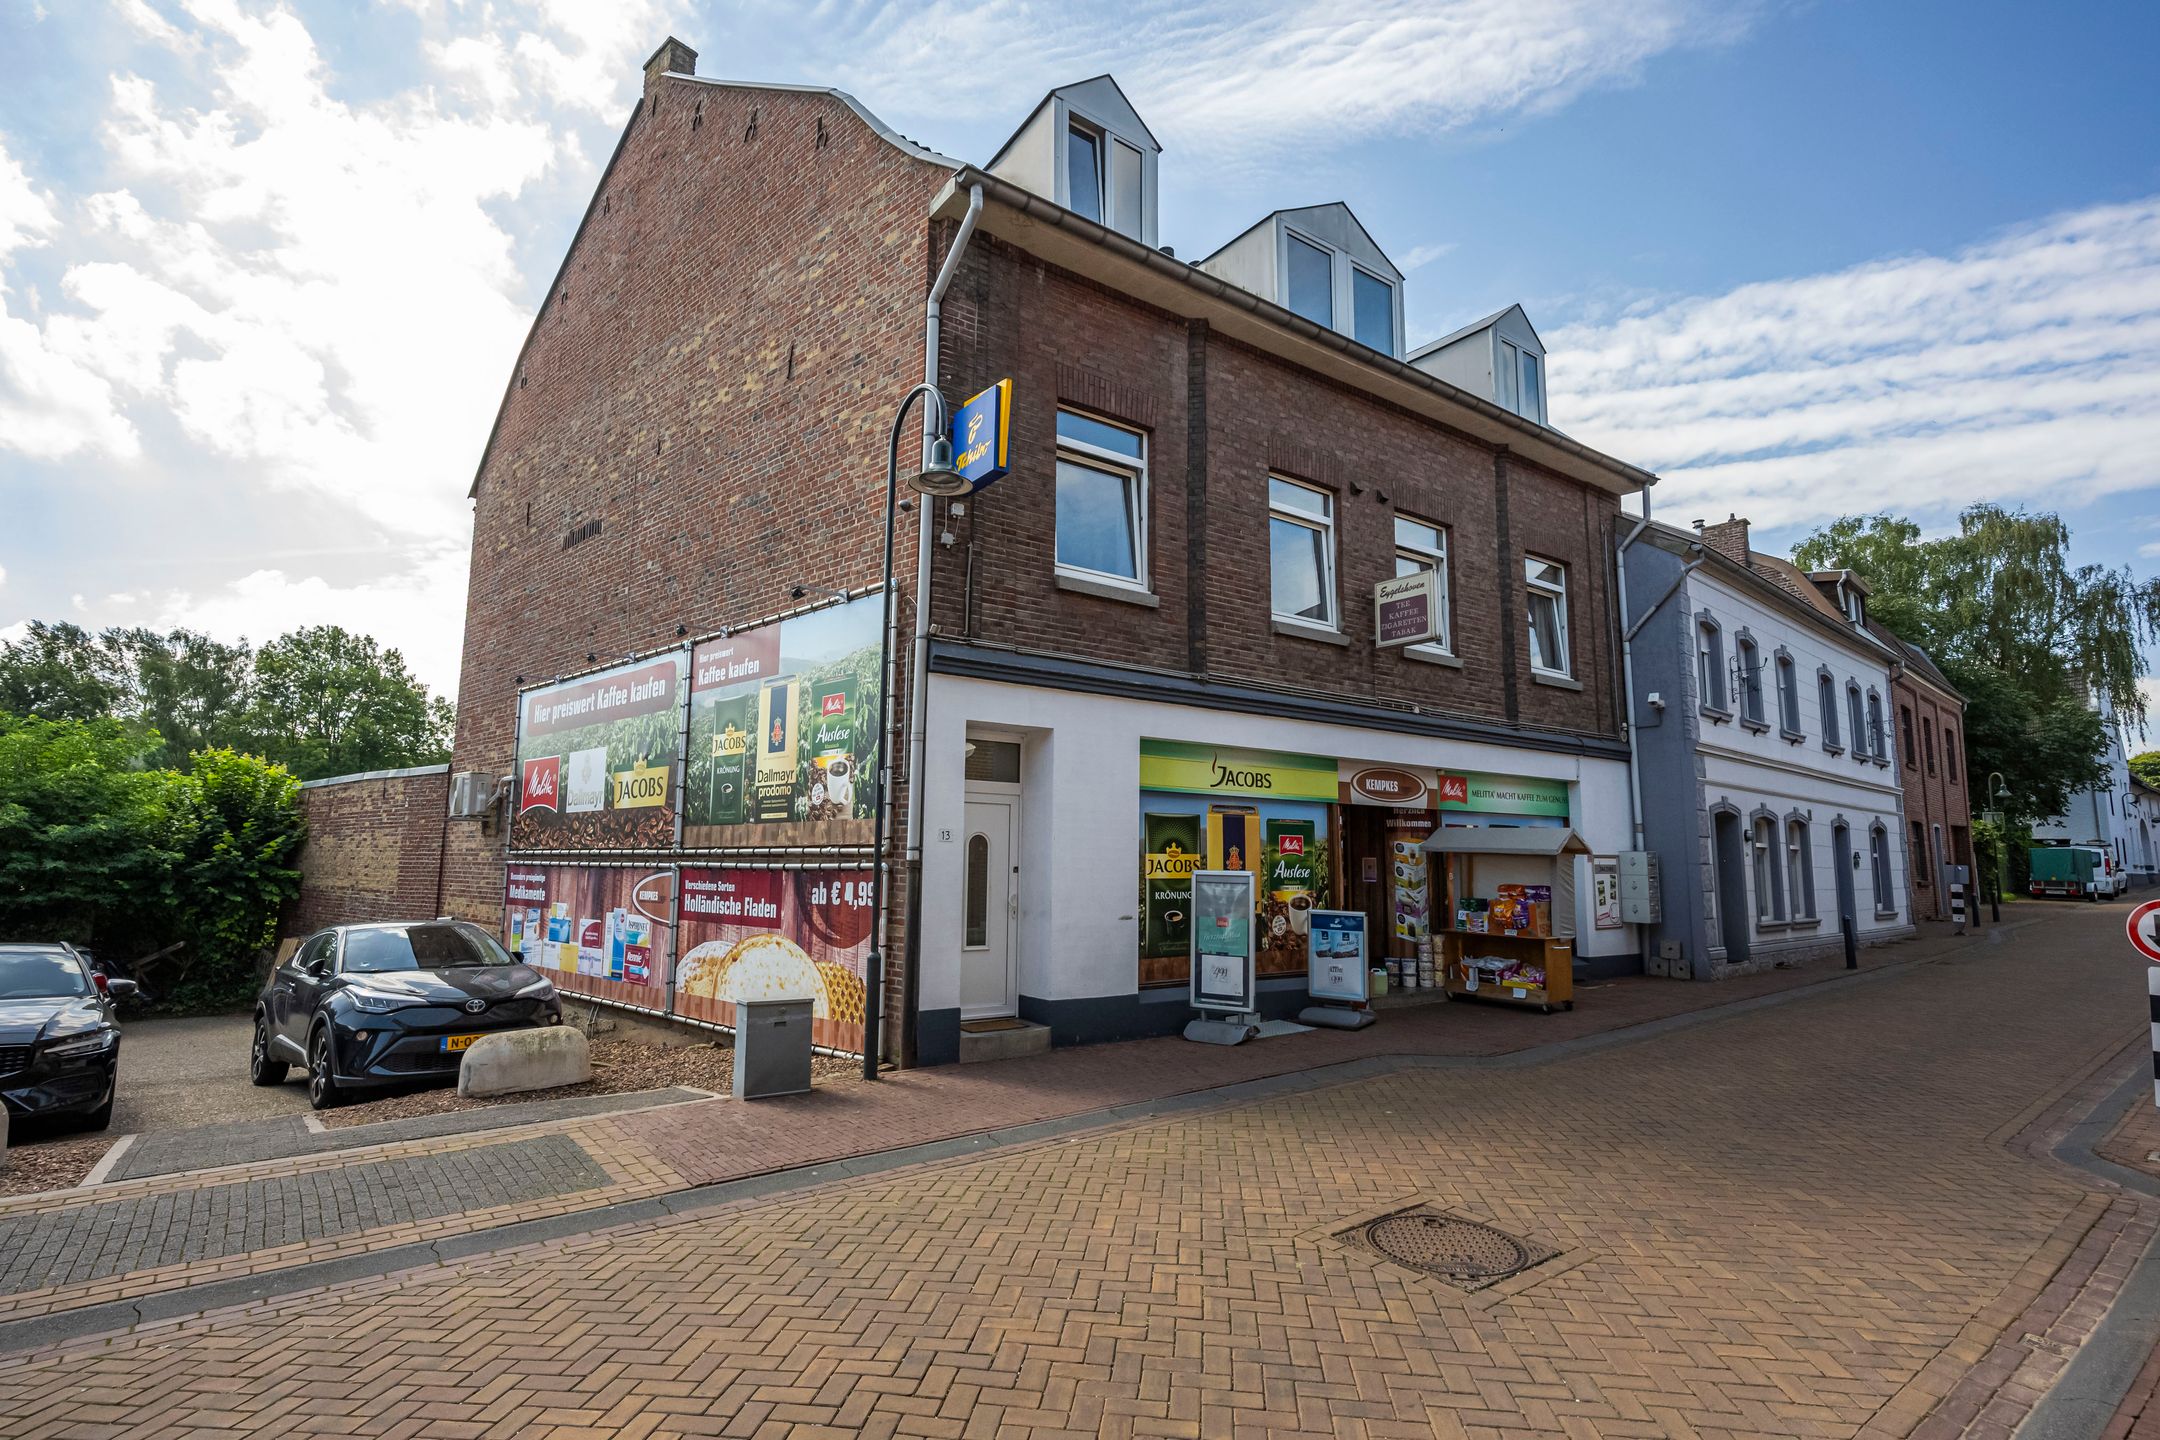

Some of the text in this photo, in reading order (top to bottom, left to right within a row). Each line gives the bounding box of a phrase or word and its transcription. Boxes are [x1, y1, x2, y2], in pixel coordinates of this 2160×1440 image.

[957, 440, 992, 471] Tchibo
[1396, 600, 1411, 608] TEE
[1389, 608, 1419, 620] KAFFEE
[1392, 627, 1416, 637] TABAK
[709, 647, 734, 661] preiswert
[698, 658, 760, 686] Kaffee kaufen
[534, 676, 666, 725] Hier preiswert Kaffee kaufen
[816, 723, 850, 744] Auslese
[714, 735, 746, 753] JACOBS
[526, 766, 553, 798] Melitta
[758, 768, 795, 785] Dallmayr
[1210, 766, 1272, 788] JACOBS
[617, 777, 664, 803] JACOBS
[758, 785, 792, 799] prodomo
[1365, 779, 1399, 792] KEMPKES
[1441, 779, 1463, 798] Melitta
[568, 789, 603, 808] Dallmayr
[1496, 791, 1516, 800] MACHT
[1517, 793, 1535, 802] KAFFEE
[1386, 819, 1431, 828] Willkommen
[942, 831, 950, 840] 13
[1147, 859, 1200, 876] JACOBS
[1273, 860, 1310, 878] Auslese
[509, 885, 545, 901] Medikamente
[685, 880, 735, 892] Verschiedene Sorten
[812, 881, 827, 905] ab
[831, 881, 841, 904] €
[684, 894, 777, 919] Holländische Fladen
